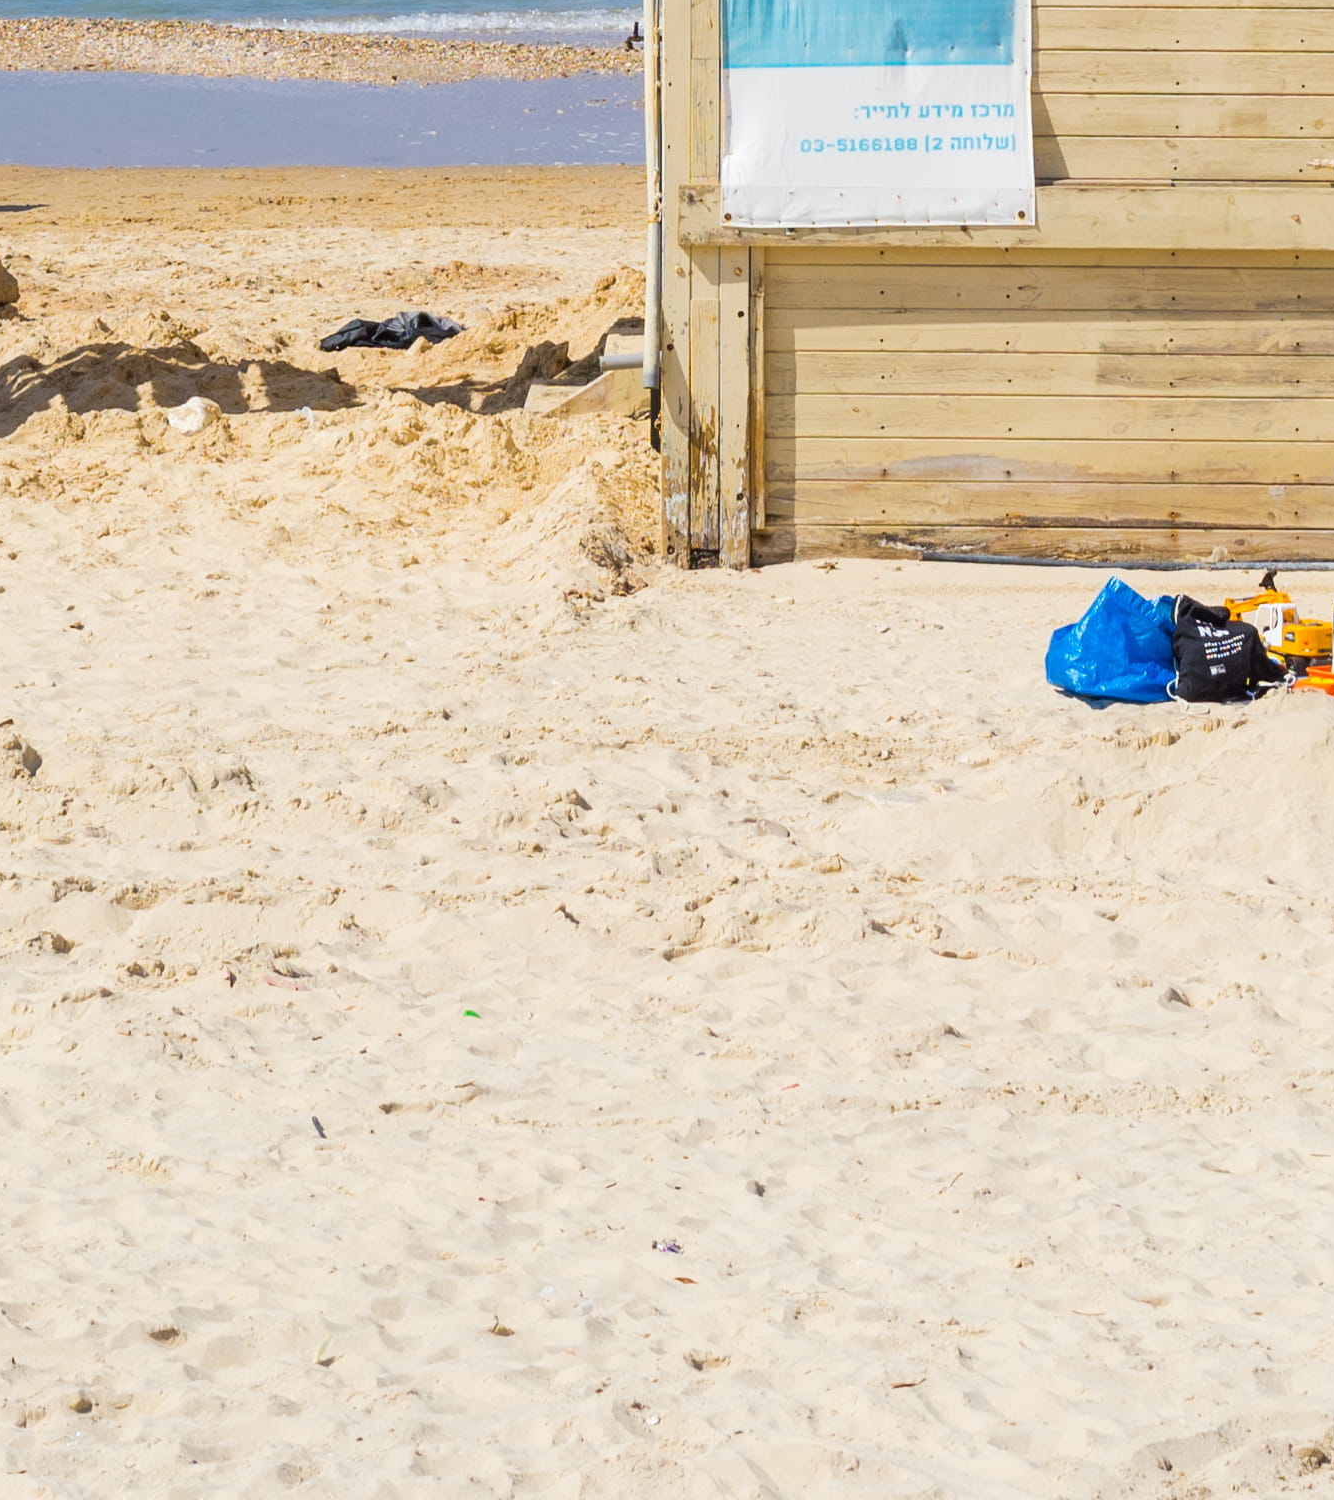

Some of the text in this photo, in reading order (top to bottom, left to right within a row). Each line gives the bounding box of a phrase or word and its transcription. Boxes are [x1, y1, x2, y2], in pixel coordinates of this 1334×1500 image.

[854, 102, 1015, 119] מרכז מידע לתייר:
[800, 137, 917, 153] 03-5166188
